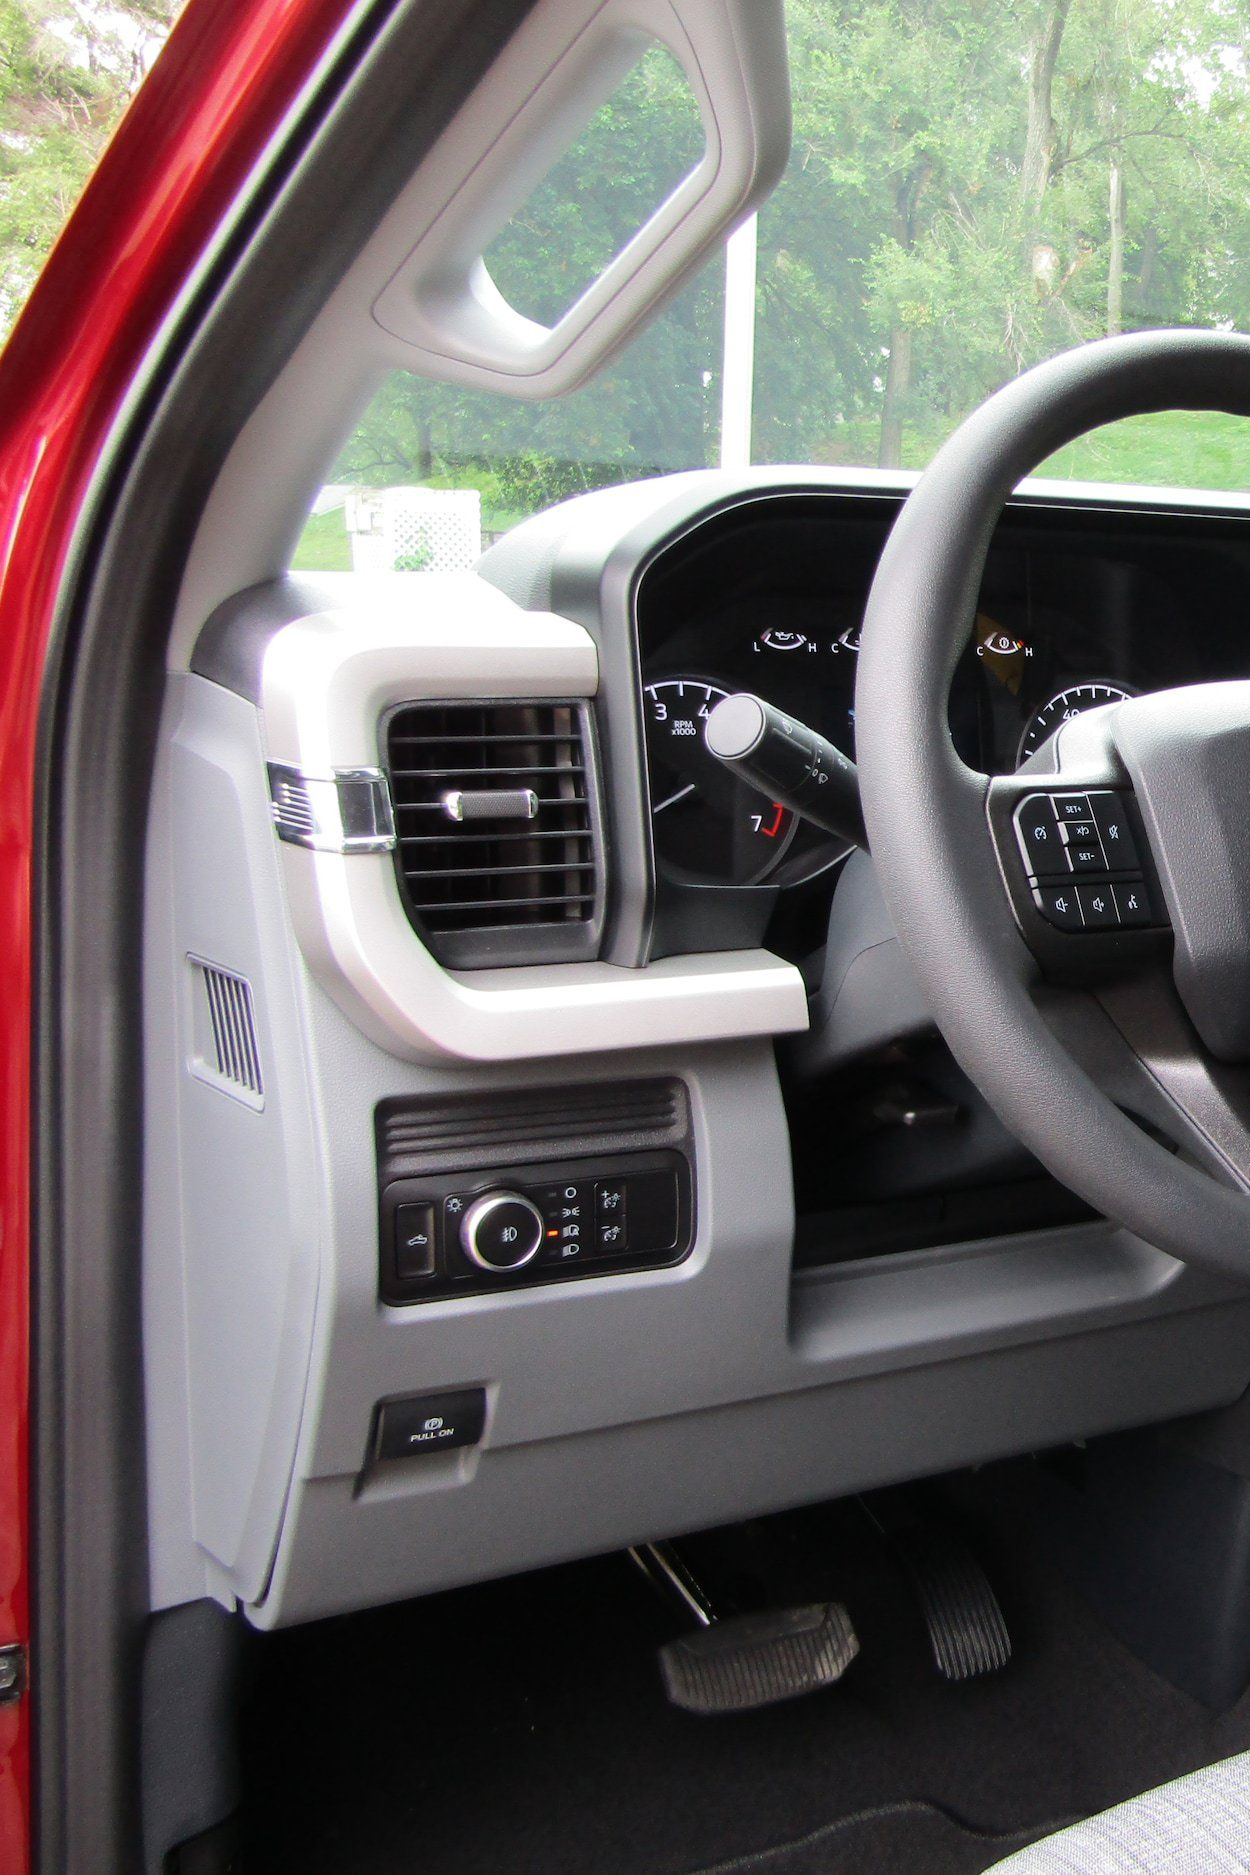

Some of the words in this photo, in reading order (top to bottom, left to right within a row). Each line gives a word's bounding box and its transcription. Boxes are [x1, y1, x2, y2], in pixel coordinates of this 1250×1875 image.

[754, 642, 760, 652] L
[809, 643, 817, 653] H
[831, 643, 839, 653] C
[976, 646, 984, 656] C
[1026, 647, 1033, 657] H
[655, 704, 668, 721] 3
[698, 704, 710, 720] 4
[671, 728, 696, 736] x1000
[1065, 805, 1082, 814] SET+
[751, 815, 762, 832] 7
[410, 1432, 437, 1443] PULL
[438, 1428, 454, 1437] ON
